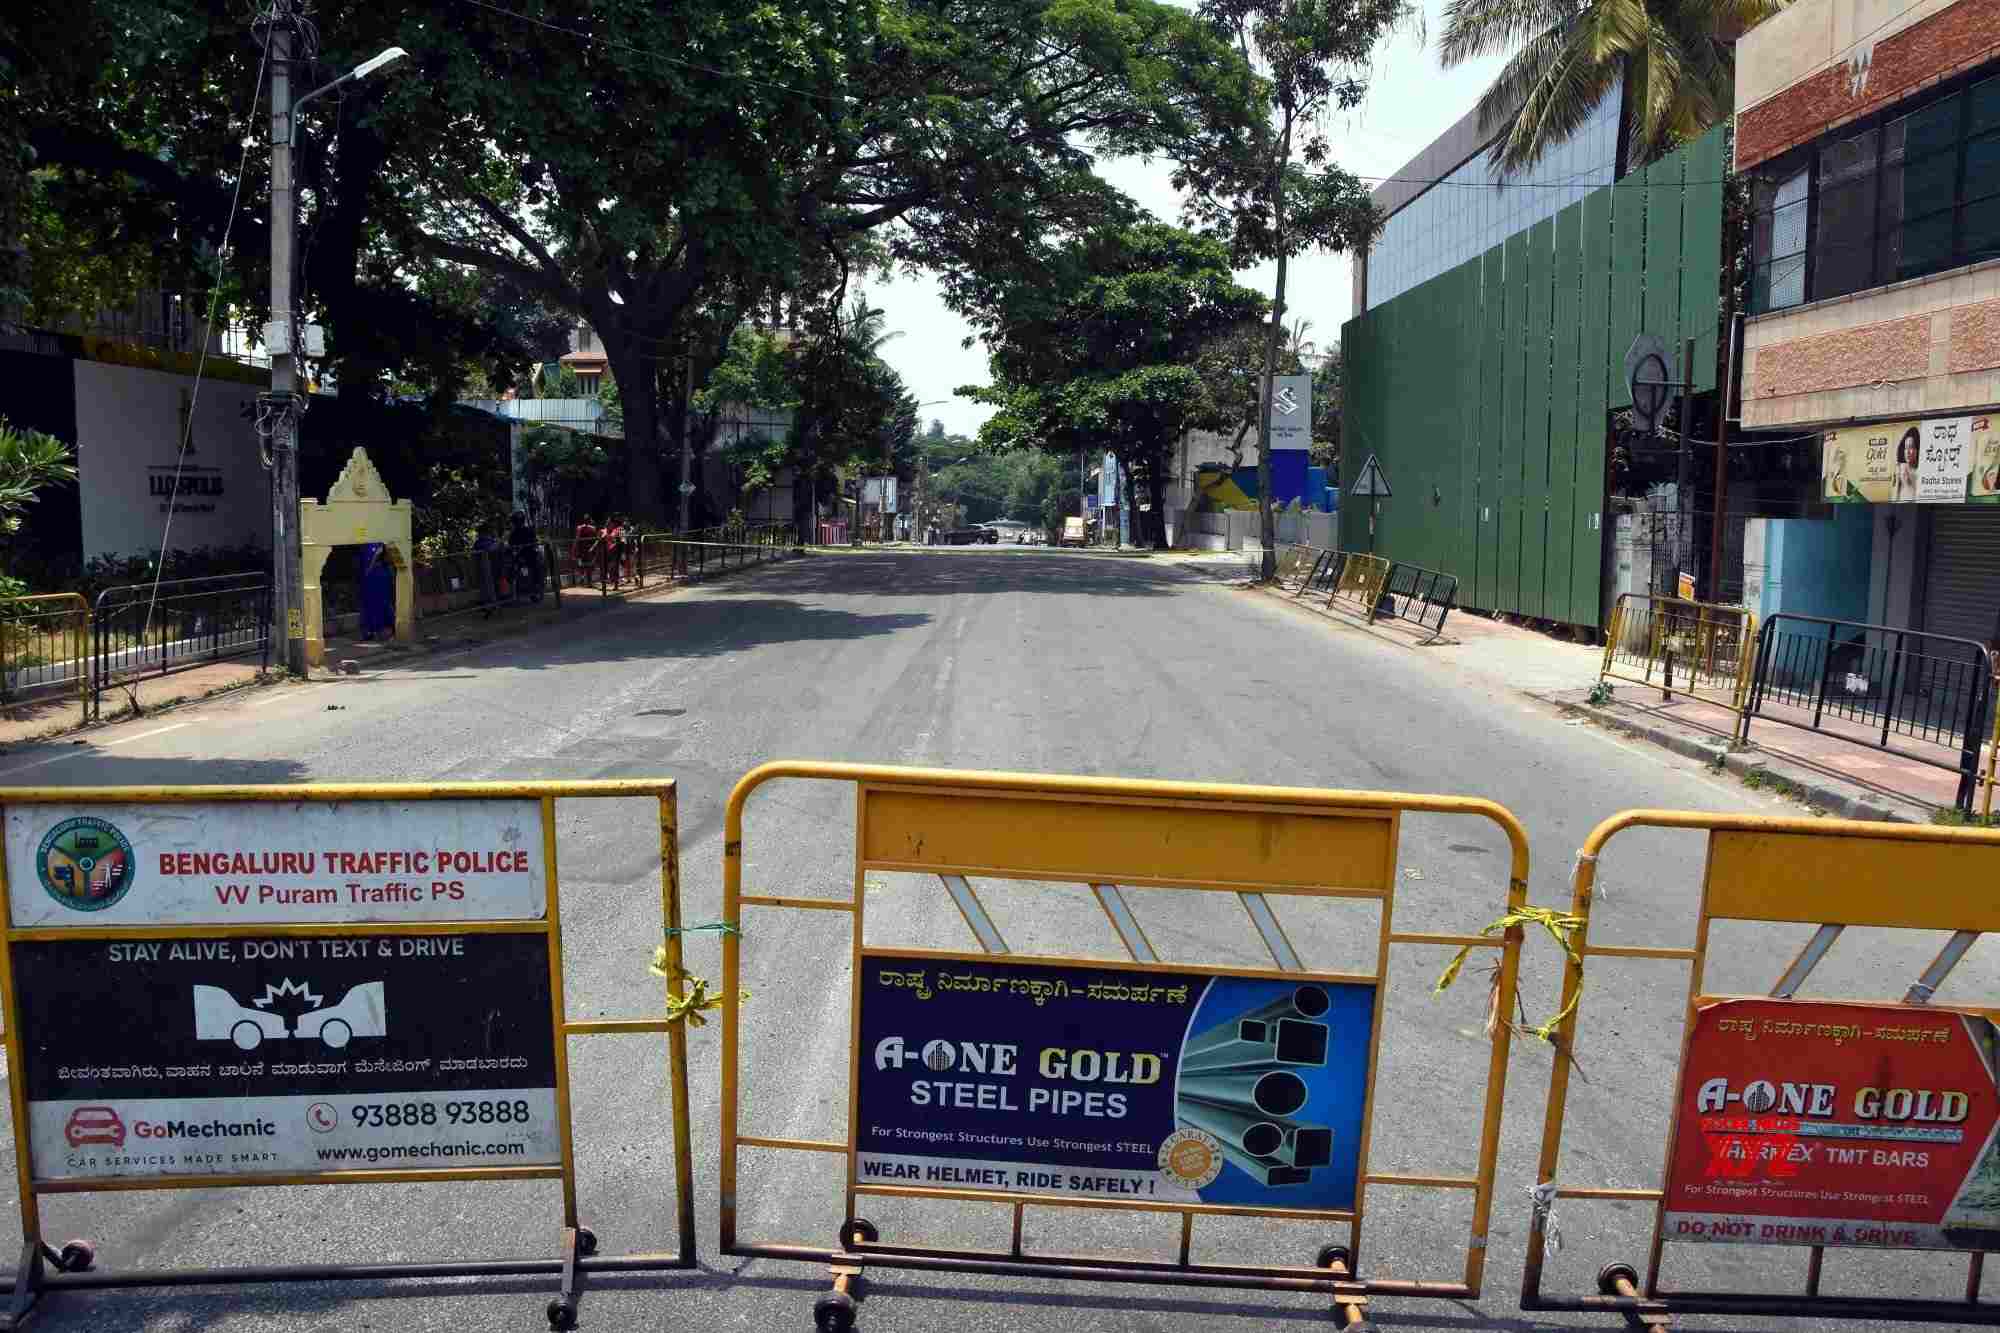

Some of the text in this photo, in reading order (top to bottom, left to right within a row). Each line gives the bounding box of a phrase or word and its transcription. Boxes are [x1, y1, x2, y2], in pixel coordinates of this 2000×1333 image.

[160, 851, 529, 875] BENGALURU TRAFFIC POLICE
[215, 882, 465, 904] VV Puram Traffic PS
[109, 938, 465, 963] STAY ALIVE, DON'T TEXT & DRIVE
[875, 1036, 1162, 1085] A-ONE GOLD
[911, 1080, 1128, 1119] STEEL PIPES
[1697, 1078, 1969, 1123] A-ONE GOLD
[352, 1100, 530, 1127] 93888 93888
[134, 1118, 276, 1141] GoMechanic
[871, 1126, 1153, 1154] For Strongest Structures Use Strongest STEEL
[67, 1153, 278, 1168] CAR SERVICES MADE SMART
[317, 1141, 525, 1162] www.gomechanic.com
[1827, 1147, 1869, 1164] TMT
[1873, 1150, 1929, 1168] BARS
[863, 1160, 921, 1180] WEAR
[927, 1165, 1009, 1188] HELMET,
[1016, 1172, 1063, 1188] RIDE
[1069, 1175, 1143, 1194] SAFELY
[1684, 1184, 1702, 1194] For
[1705, 1185, 1757, 1198] Strongest
[1677, 1220, 1705, 1235] DO
[1711, 1222, 1754, 1237] NOT
[1760, 1224, 1825, 1241] DRINK
[1854, 1229, 1915, 1245] DRIVE
